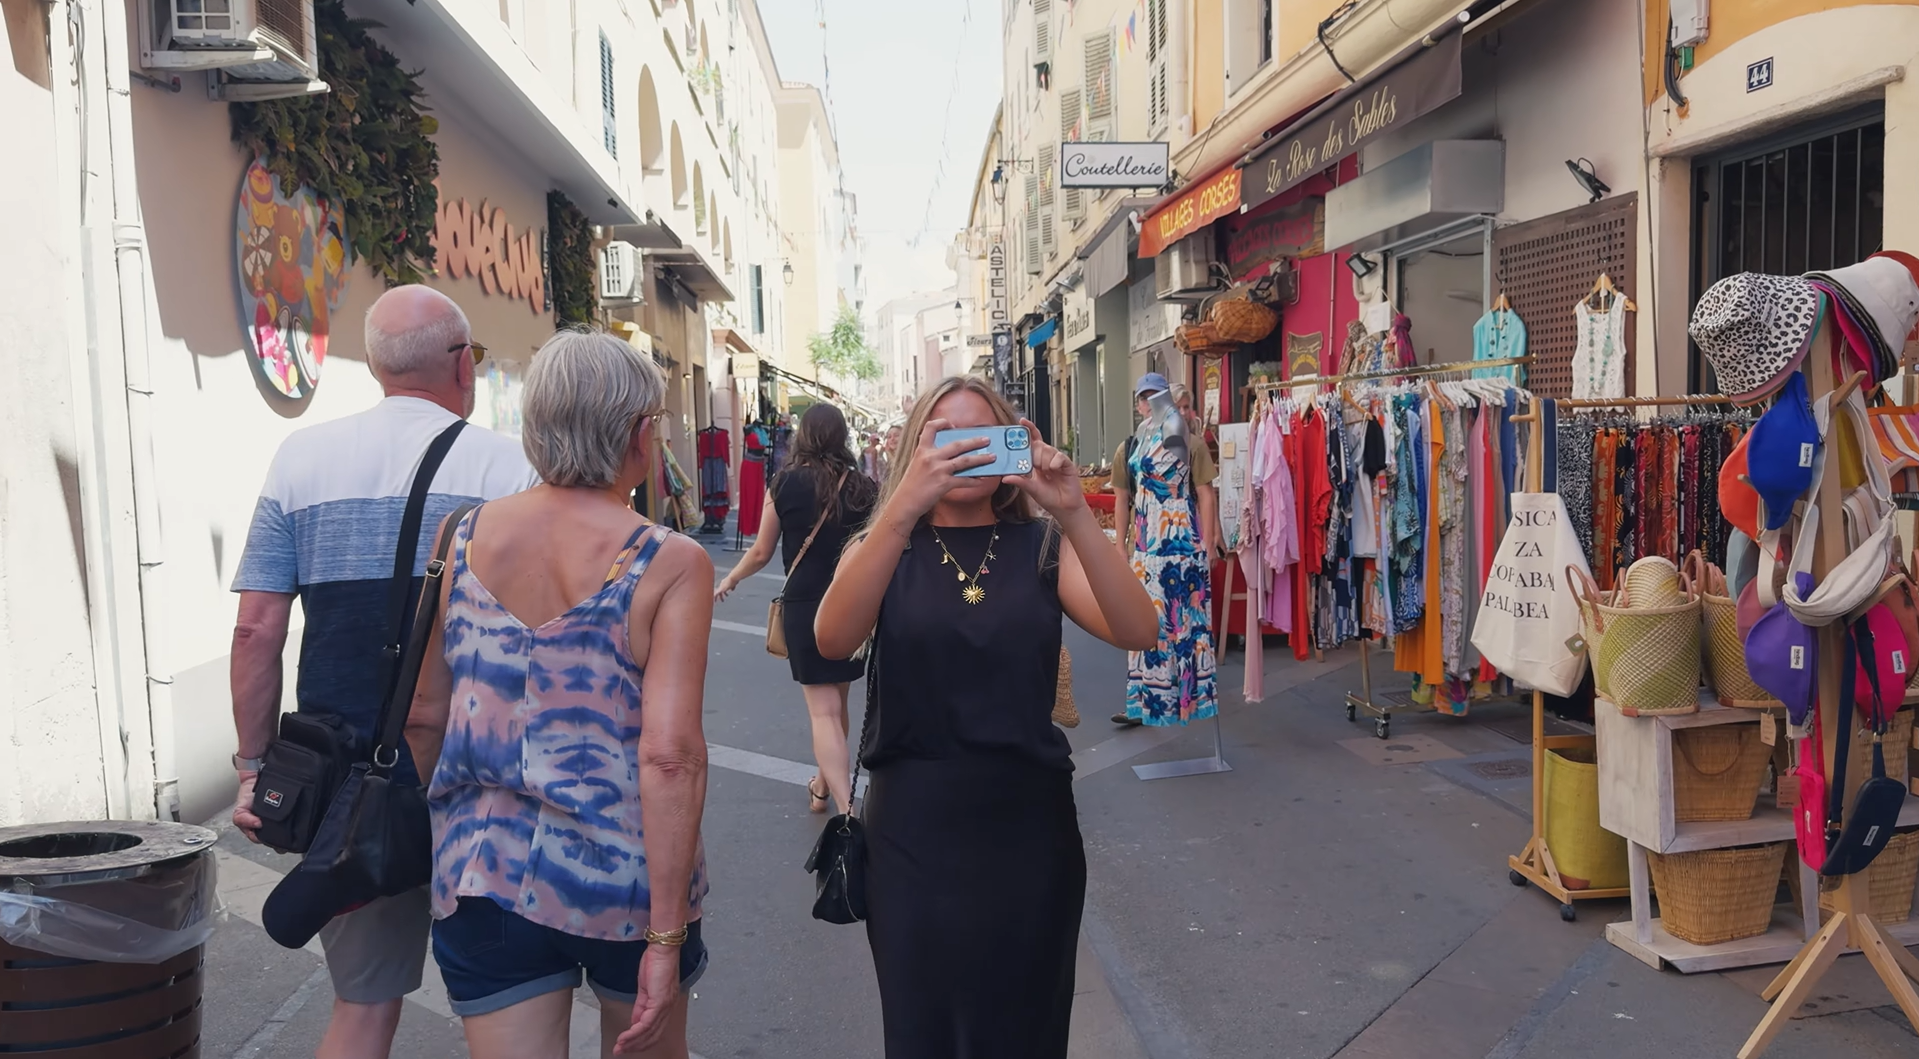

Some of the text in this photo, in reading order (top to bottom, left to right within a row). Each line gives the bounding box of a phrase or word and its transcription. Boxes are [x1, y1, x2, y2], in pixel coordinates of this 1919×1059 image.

[1750, 63, 1769, 87] 44
[1266, 85, 1397, 194] La Rose des Sables
[1065, 152, 1165, 178] Coutellerie
[1160, 173, 1236, 239] VILLAGES CORSES
[990, 233, 1004, 331] ASTELICA
[1515, 541, 1544, 558] ZA
